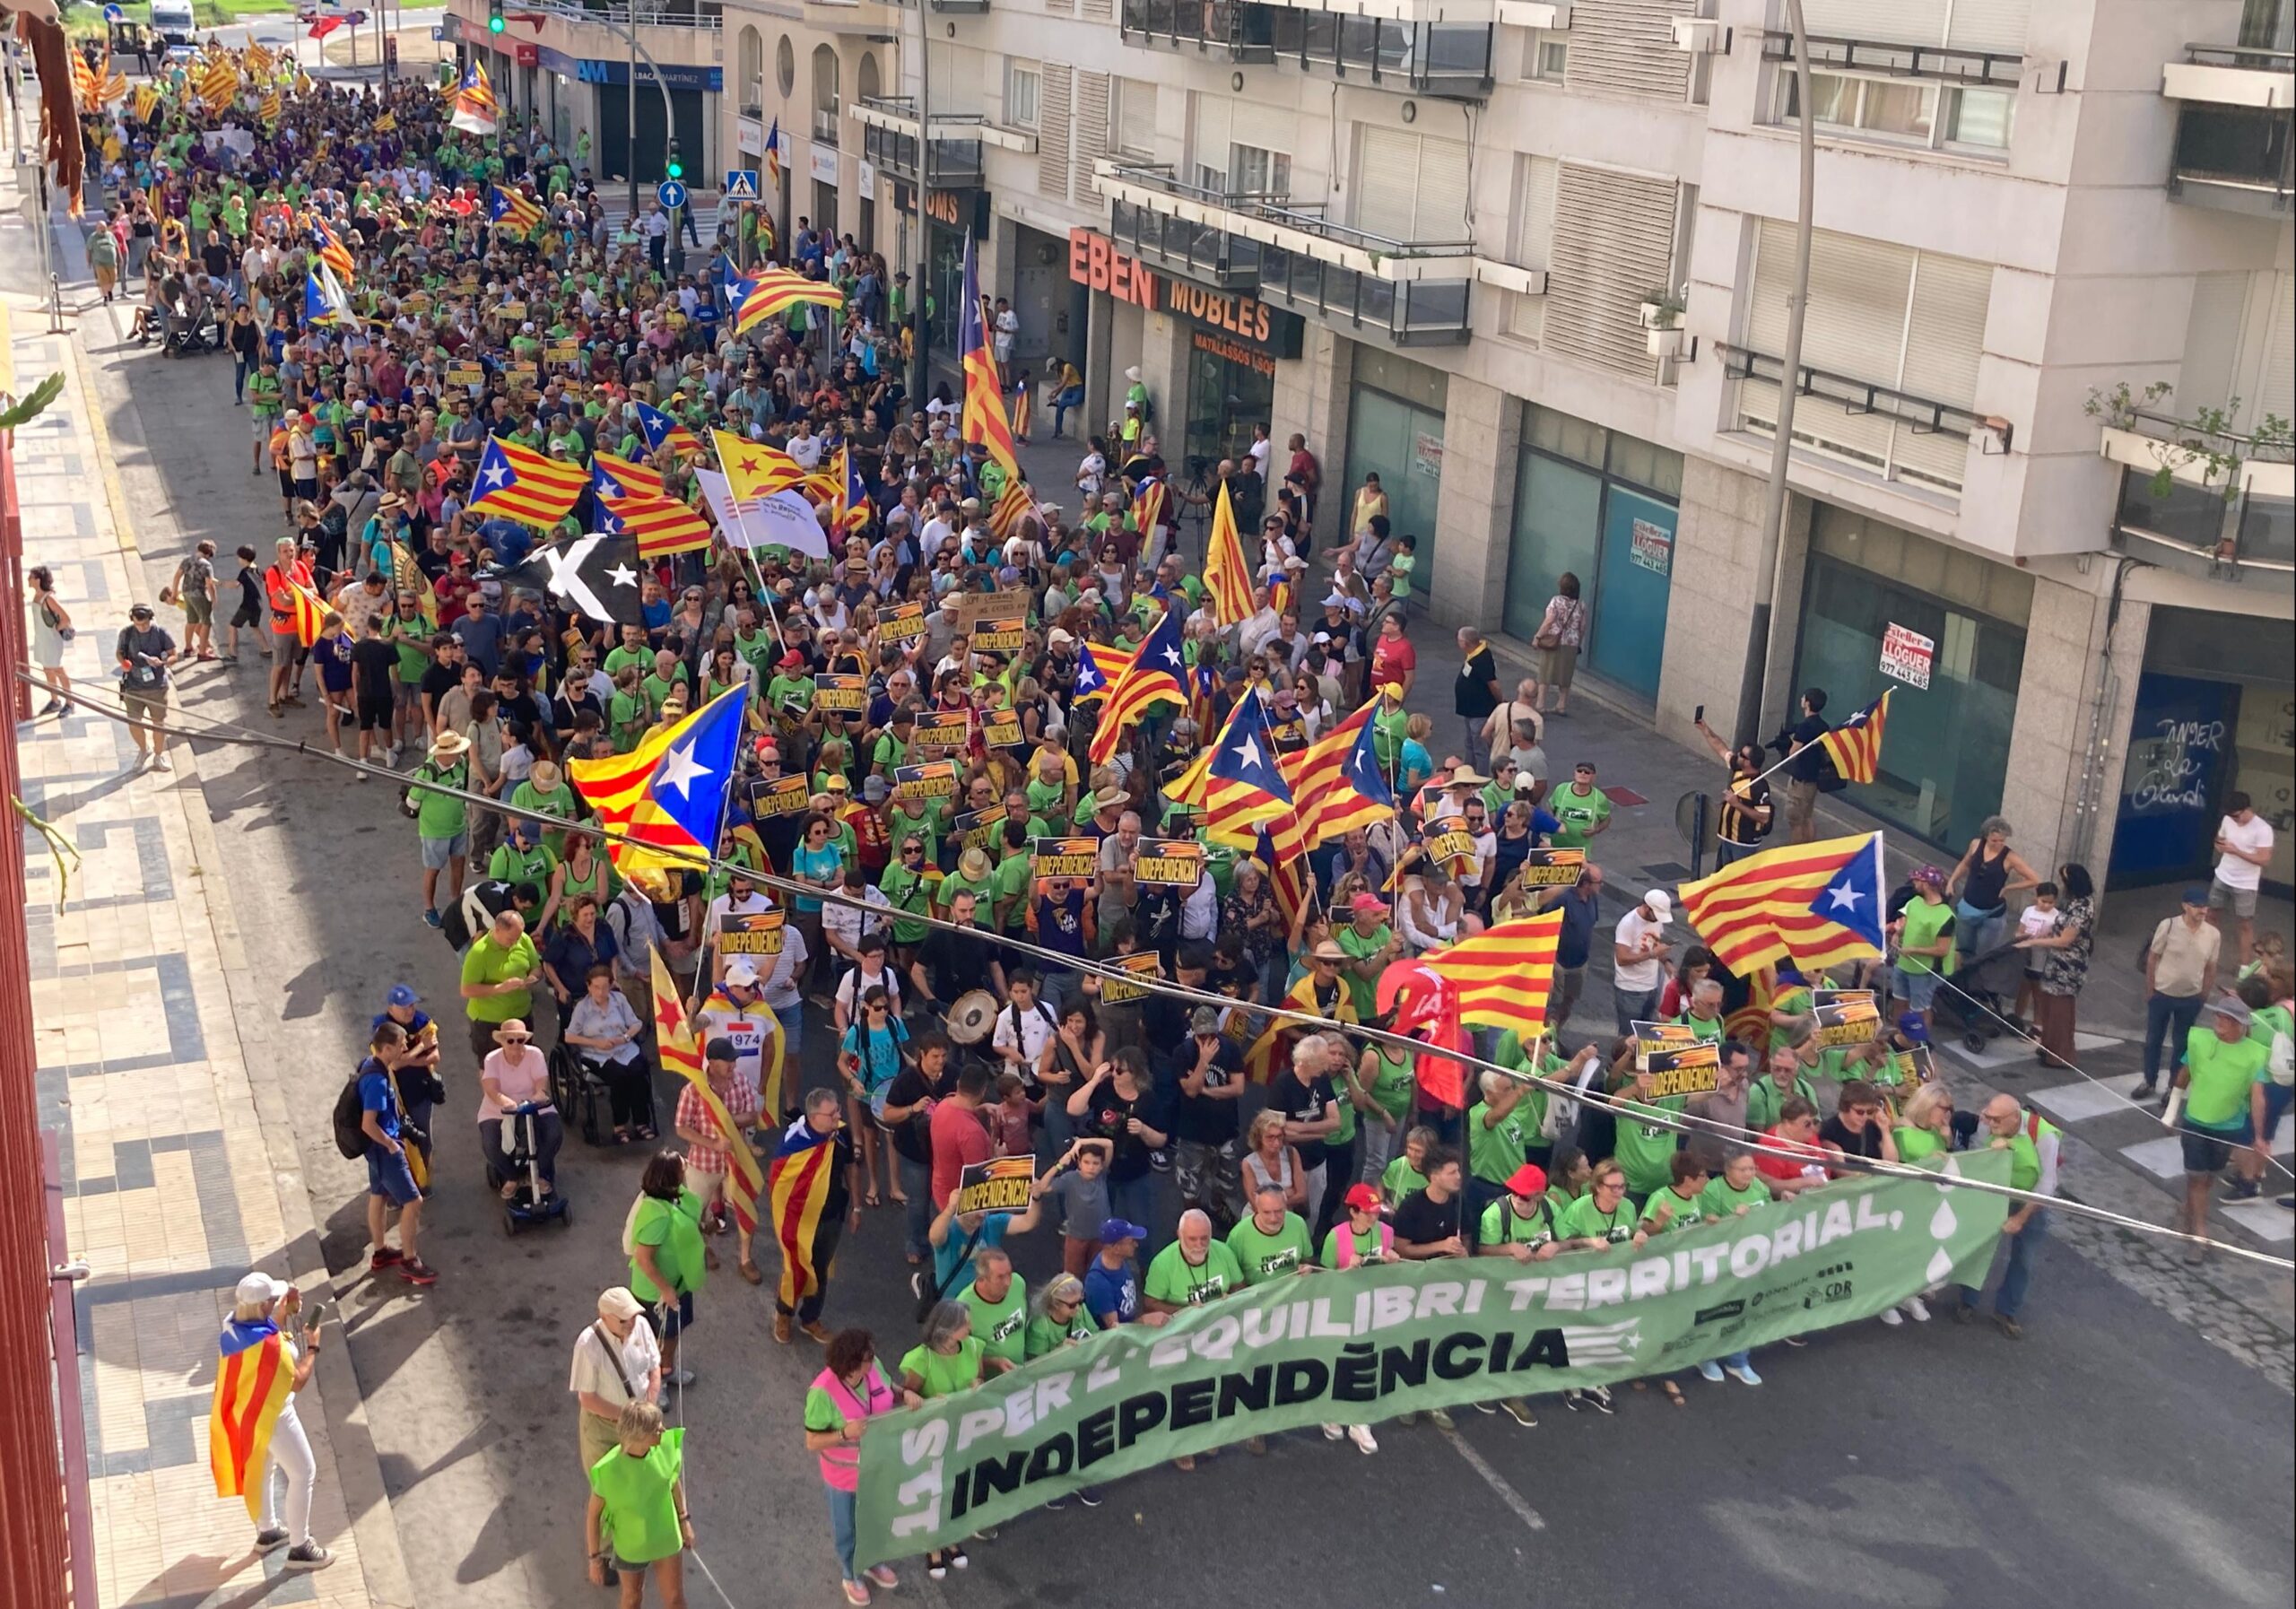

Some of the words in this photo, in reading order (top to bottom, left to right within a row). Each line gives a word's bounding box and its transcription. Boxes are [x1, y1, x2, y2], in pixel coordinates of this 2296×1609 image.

[434, 29, 442, 39] P
[1070, 227, 1155, 311] EBEN
[1170, 279, 1270, 342] MOBLES
[1195, 333, 1249, 366] MATALASSOS
[1632, 535, 1668, 561] LLOGUER
[1883, 640, 1931, 674] LLOGUER
[1881, 661, 1895, 674] 977
[1897, 668, 1911, 682] 443
[1913, 674, 1927, 689] 485
[728, 1033, 761, 1047] 1974
[1825, 1281, 1852, 1297] CDR
[891, 1418, 949, 1537] 11S
[957, 1371, 1075, 1452] PER
[1504, 1193, 1904, 1311] TERRITORIAL,
